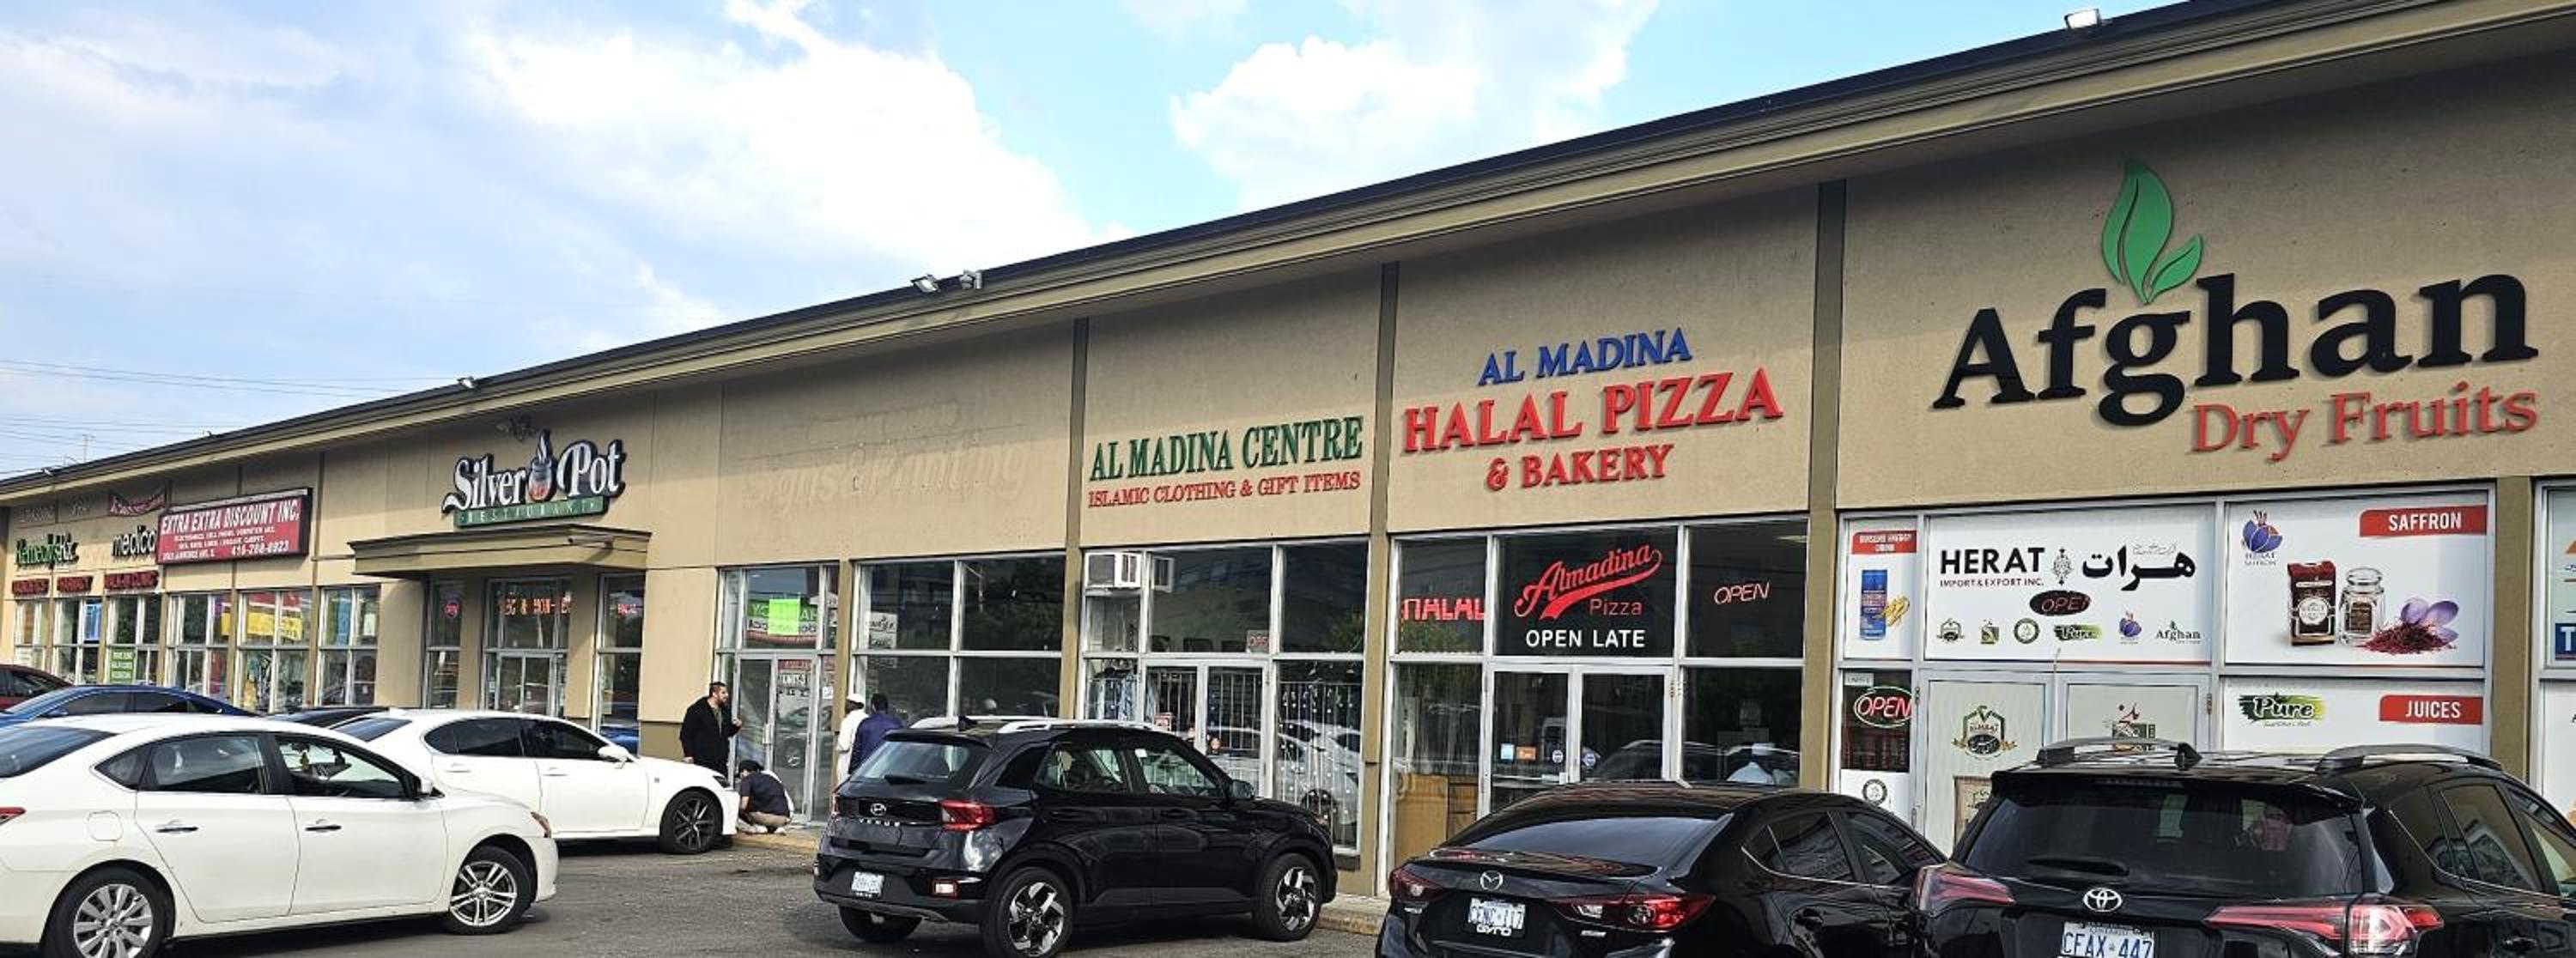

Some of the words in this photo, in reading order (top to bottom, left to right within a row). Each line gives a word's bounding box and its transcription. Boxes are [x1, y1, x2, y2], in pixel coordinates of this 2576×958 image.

[1478, 351, 1525, 385] AL
[1536, 326, 1693, 379] MADINA
[1932, 272, 2539, 427] Afghan
[1403, 390, 1583, 453] HALAL
[1601, 367, 1783, 434] PIZZA
[2191, 401, 2310, 463] Dry
[2329, 380, 2539, 446] Fruits
[1089, 442, 1123, 482] AL
[1127, 430, 1234, 478] MADINA
[1242, 415, 1364, 470] CENTRE
[442, 453, 528, 512] Silver
[556, 440, 626, 498] Pot
[1485, 458, 1509, 492] &
[1521, 443, 1674, 489] BAKERY
[1088, 487, 1150, 508] ISLAMIC
[1153, 481, 1236, 504] CLOTHING
[1239, 479, 1253, 497] &
[1258, 475, 1299, 496] GIFT
[1303, 471, 1361, 493] ITEMS
[161, 514, 190, 535] EXTRA
[191, 511, 221, 531] EXTRA
[224, 502, 276, 529] DISCOUNT
[2388, 512, 2462, 531] SAFFRON
[1941, 547, 2045, 574] HERAT
[2081, 544, 2196, 591] هرات
[1514, 543, 1662, 619] Almadina
[1714, 582, 1771, 606] OPEN
[1984, 578, 2021, 586] EXPORT
[2024, 578, 2044, 586] INC.
[1589, 597, 1643, 616] Pizza
[1525, 629, 1583, 649] OPEN
[1592, 629, 1646, 648] LATE
[2156, 629, 2201, 640] Afghan
[1857, 696, 1911, 718] OPEN
[2253, 696, 2314, 718] Pure
[2405, 701, 2461, 719] JUICES
